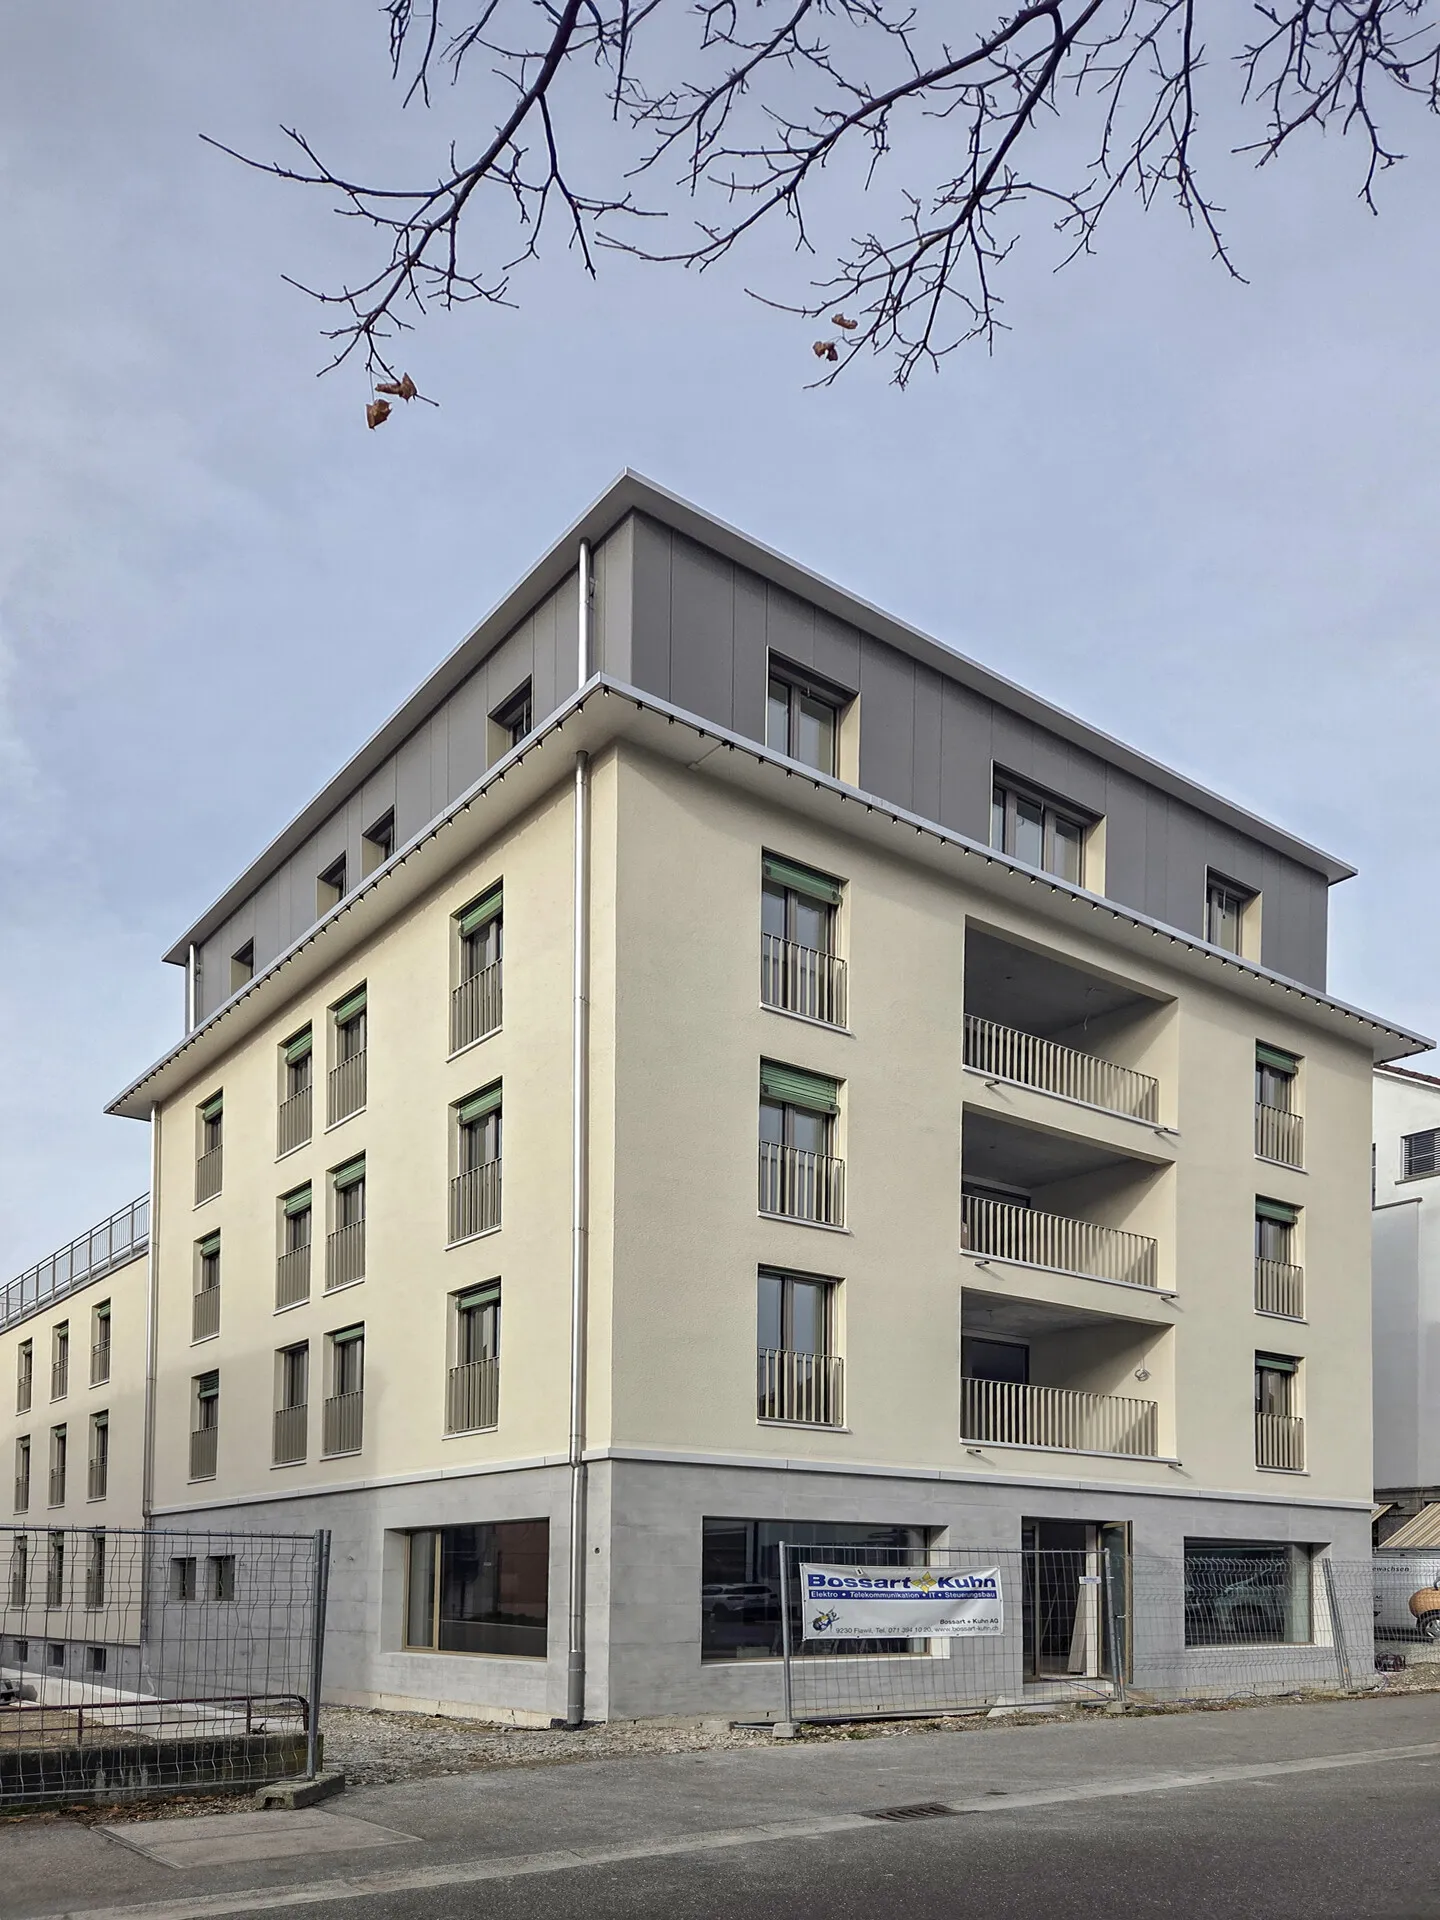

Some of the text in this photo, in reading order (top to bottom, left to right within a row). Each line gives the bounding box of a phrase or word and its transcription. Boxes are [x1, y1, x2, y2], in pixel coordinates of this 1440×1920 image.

[807, 1573, 997, 1589] Bossart Kuhn
[811, 1590, 838, 1598] Elektro
[850, 1591, 919, 1599] Telekommunikation
[944, 1591, 995, 1599] Steuerungsbau
